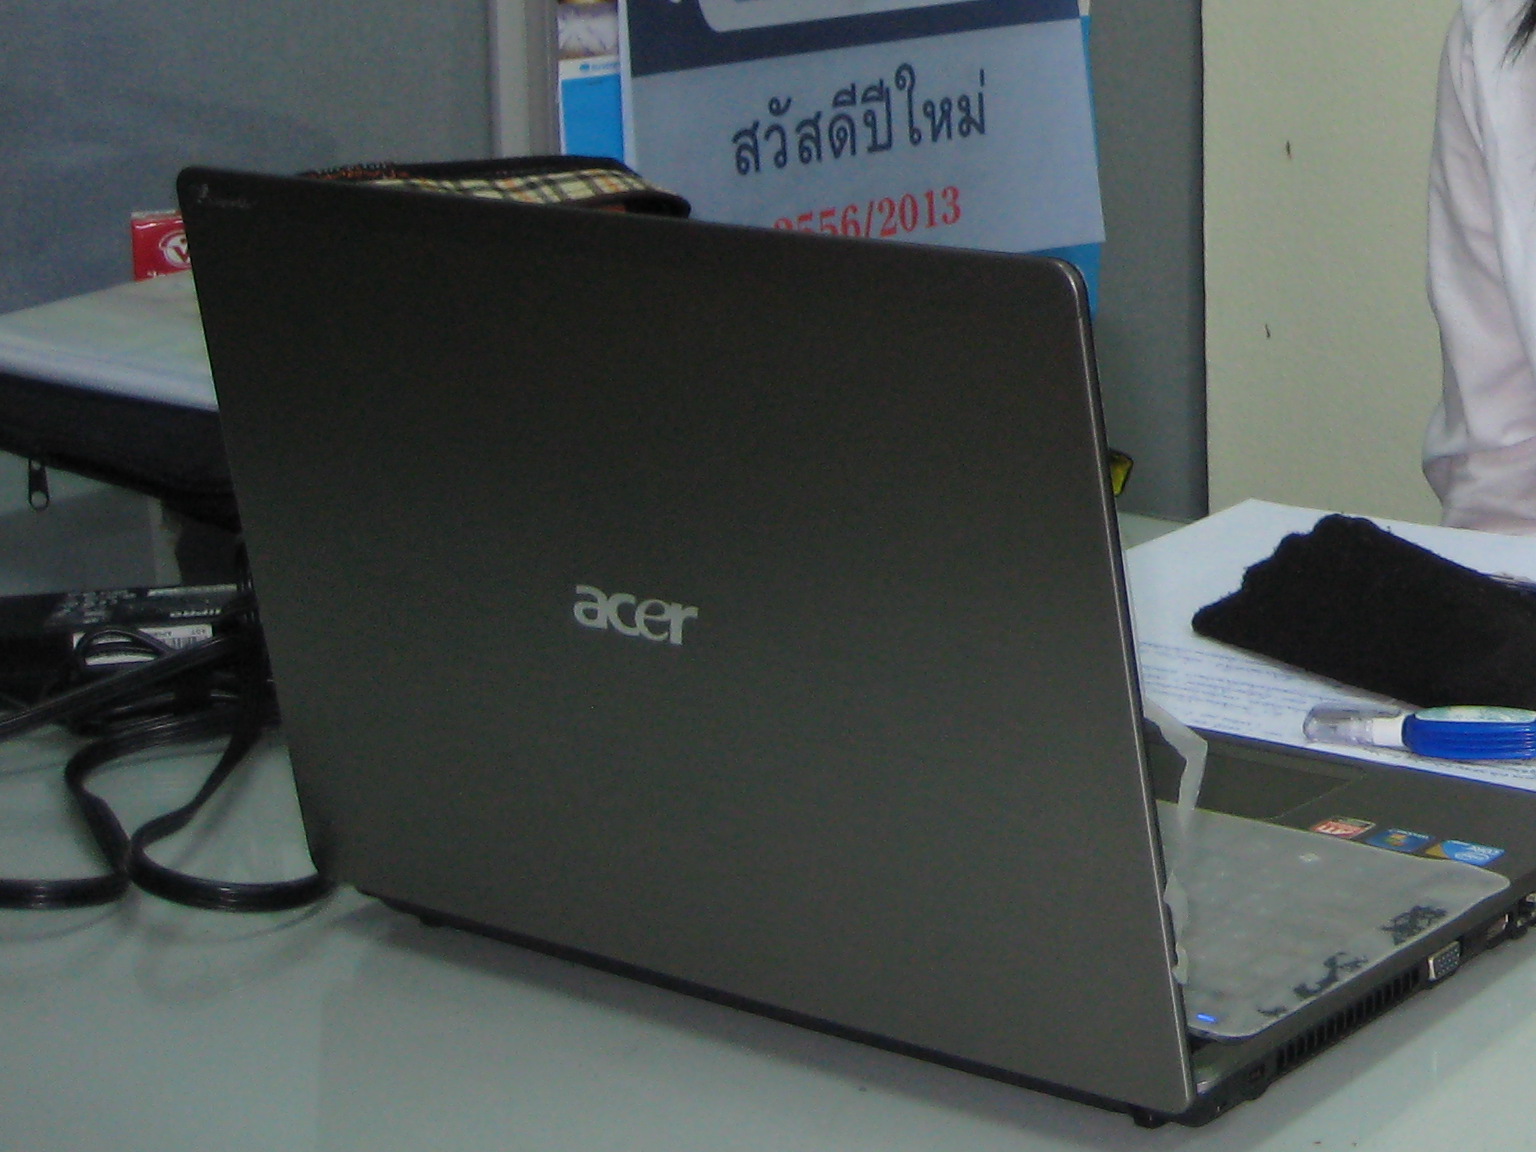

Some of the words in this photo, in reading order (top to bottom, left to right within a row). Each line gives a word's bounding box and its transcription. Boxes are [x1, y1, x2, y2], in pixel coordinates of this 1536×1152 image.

[732, 63, 985, 176] สวัสดีปีใหม่
[573, 584, 699, 645] acer
